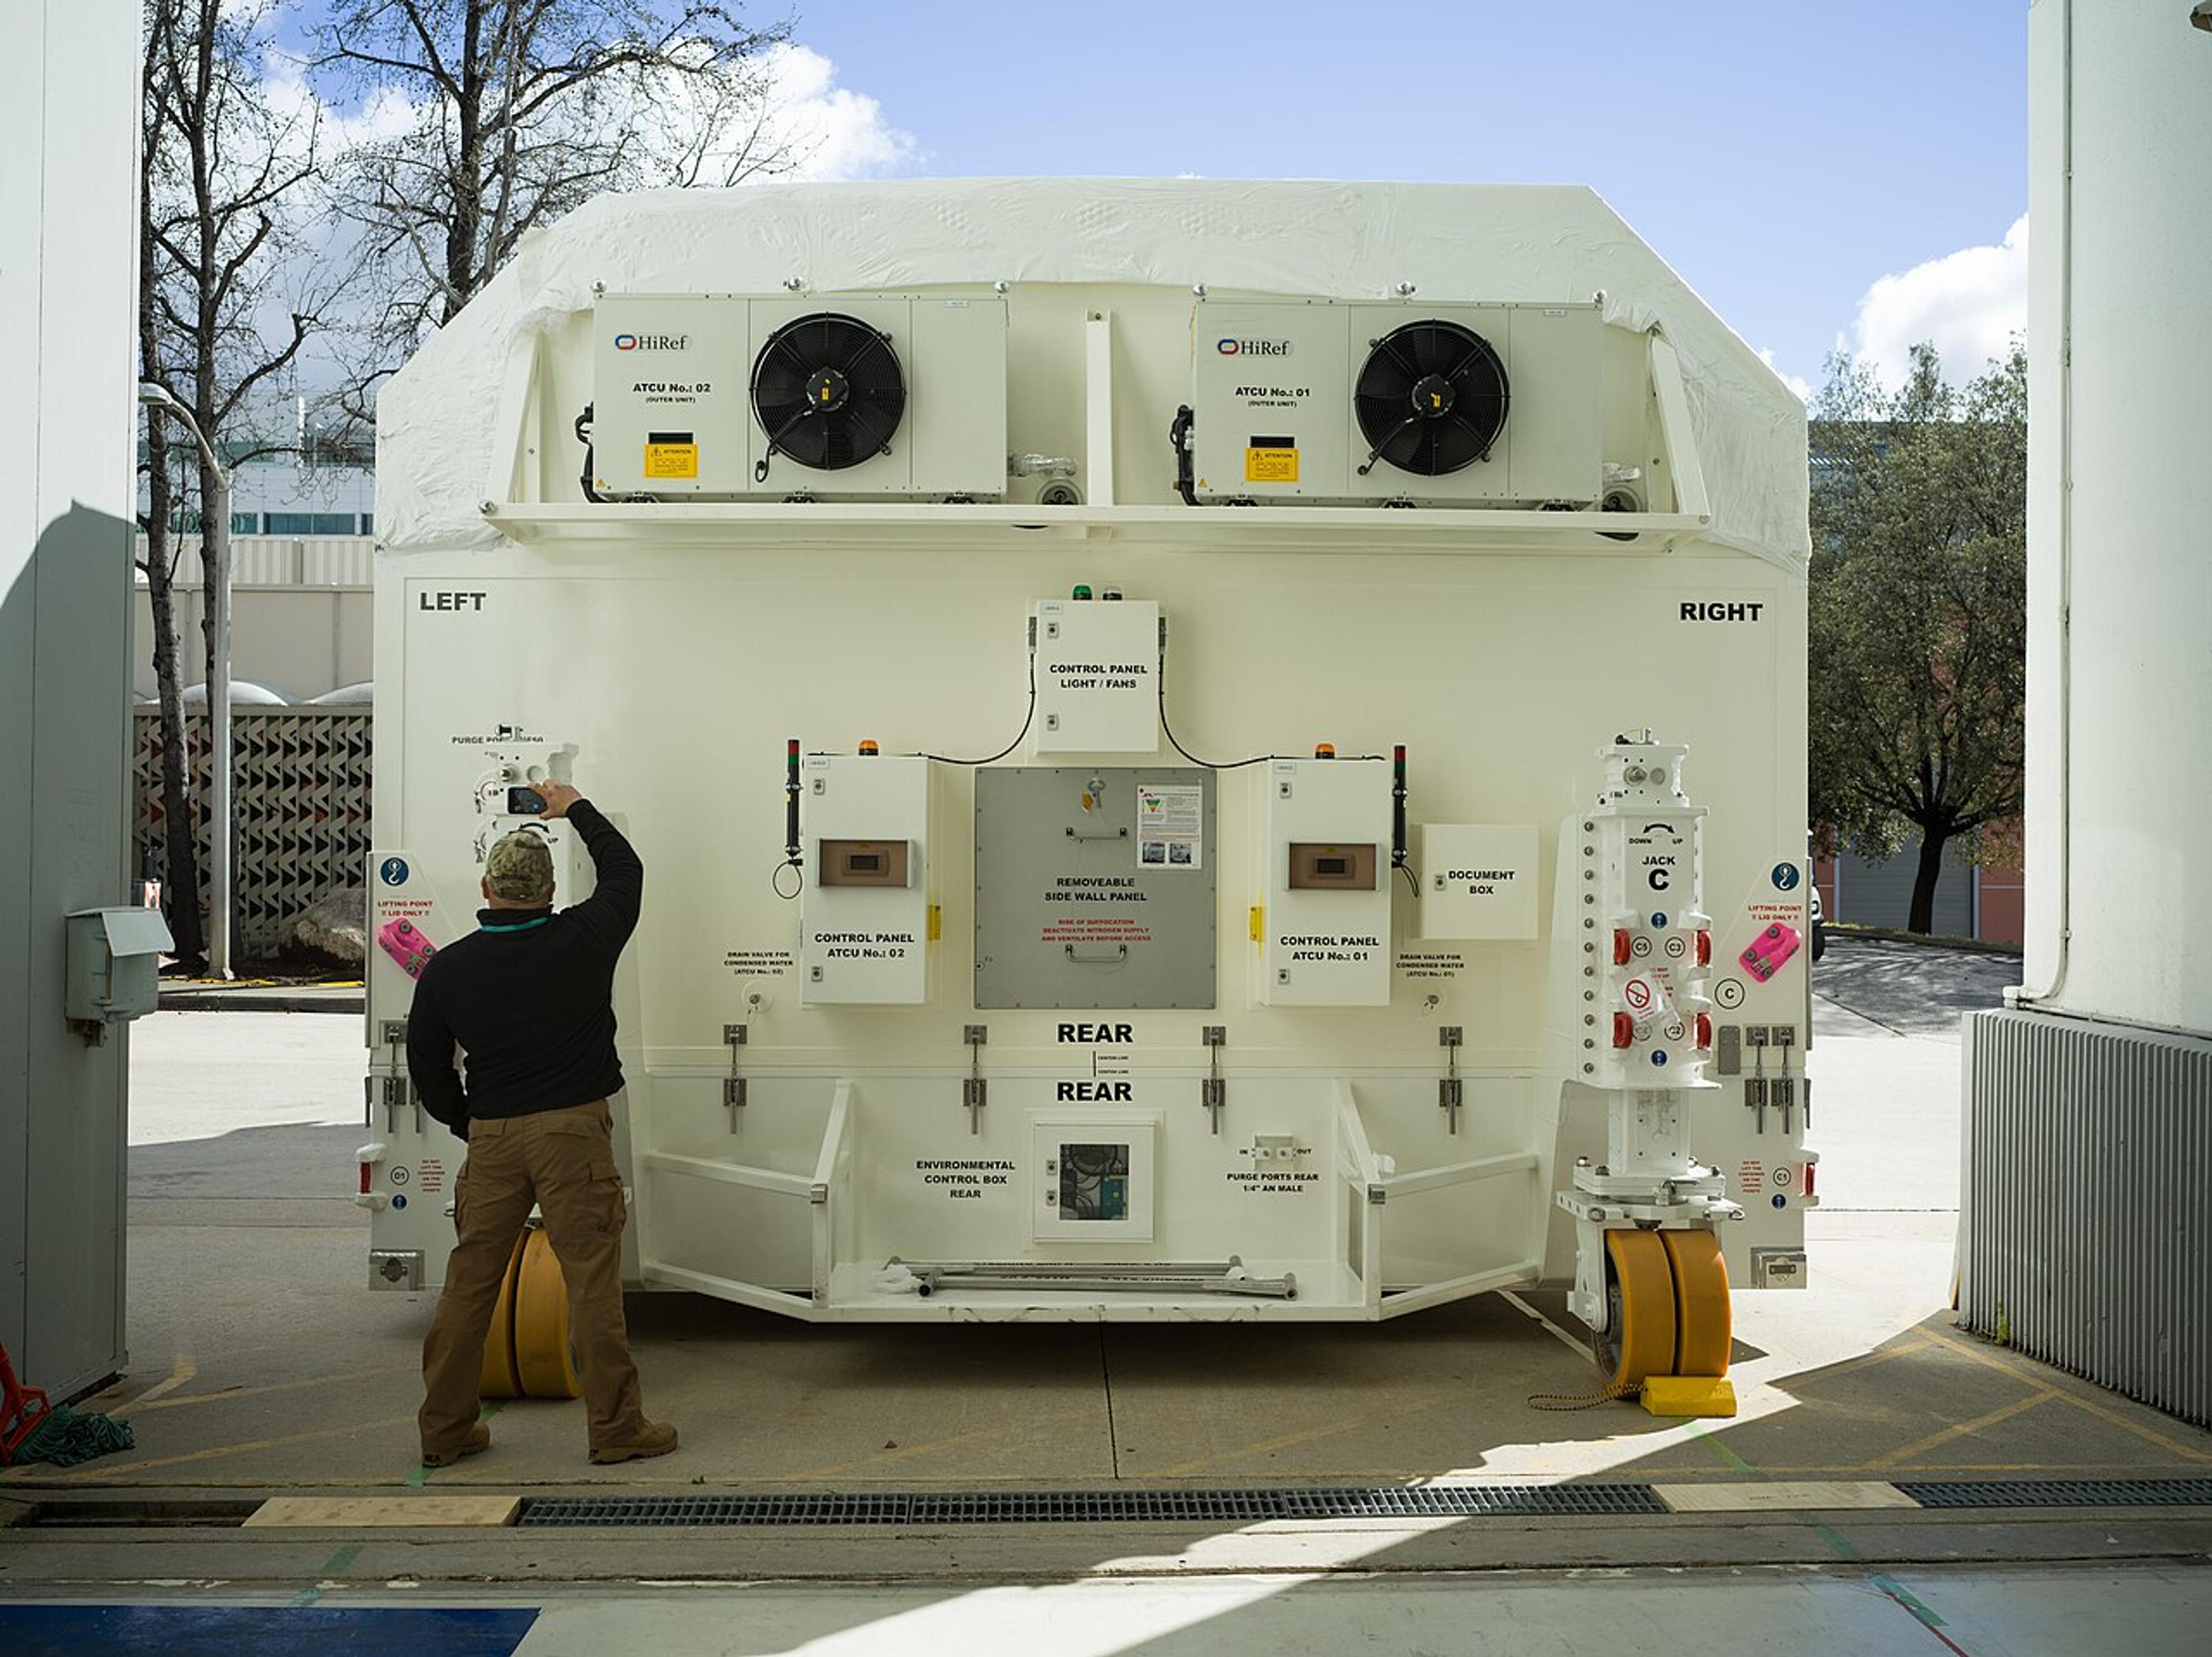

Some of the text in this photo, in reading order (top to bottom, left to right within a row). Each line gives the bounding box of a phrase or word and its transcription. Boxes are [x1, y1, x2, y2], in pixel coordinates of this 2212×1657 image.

[638, 335, 688, 350] HiRef
[1241, 340, 1290, 355] HiRef
[633, 383, 711, 393] ATCU No.: 02
[1235, 386, 1310, 397] ATCU No.: 01
[420, 592, 486, 611] LEFT
[1680, 602, 1763, 621] RIGHT
[1050, 665, 1148, 674] CONTROL PANEL
[1060, 679, 1096, 688] LIGHT
[1106, 679, 1137, 688] FANS
[1642, 855, 1676, 865] JACK
[1449, 871, 1515, 881] DOCUMENT
[1649, 869, 1669, 890] C
[1057, 878, 1135, 887] REMOVEABLE
[1469, 886, 1494, 895] BOX
[1045, 892, 1147, 901] SIDE WALL PANEL
[814, 933, 914, 943] CONTROL PANEL
[1280, 936, 1380, 946] CONTROL PANEL
[827, 948, 905, 958] ATCU No.: 02
[1292, 951, 1368, 961] ATCU No.: 01
[1725, 988, 1735, 999] C
[1058, 1023, 1133, 1042] REAR
[1669, 1026, 1681, 1034] C2
[1057, 1082, 1132, 1101] REAR
[916, 1160, 1015, 1170] ENVIRONMENTAL
[924, 1175, 1007, 1184] CONTROL BOX
[1294, 1173, 1320, 1181] REAR
[949, 1189, 981, 1199] REAR
